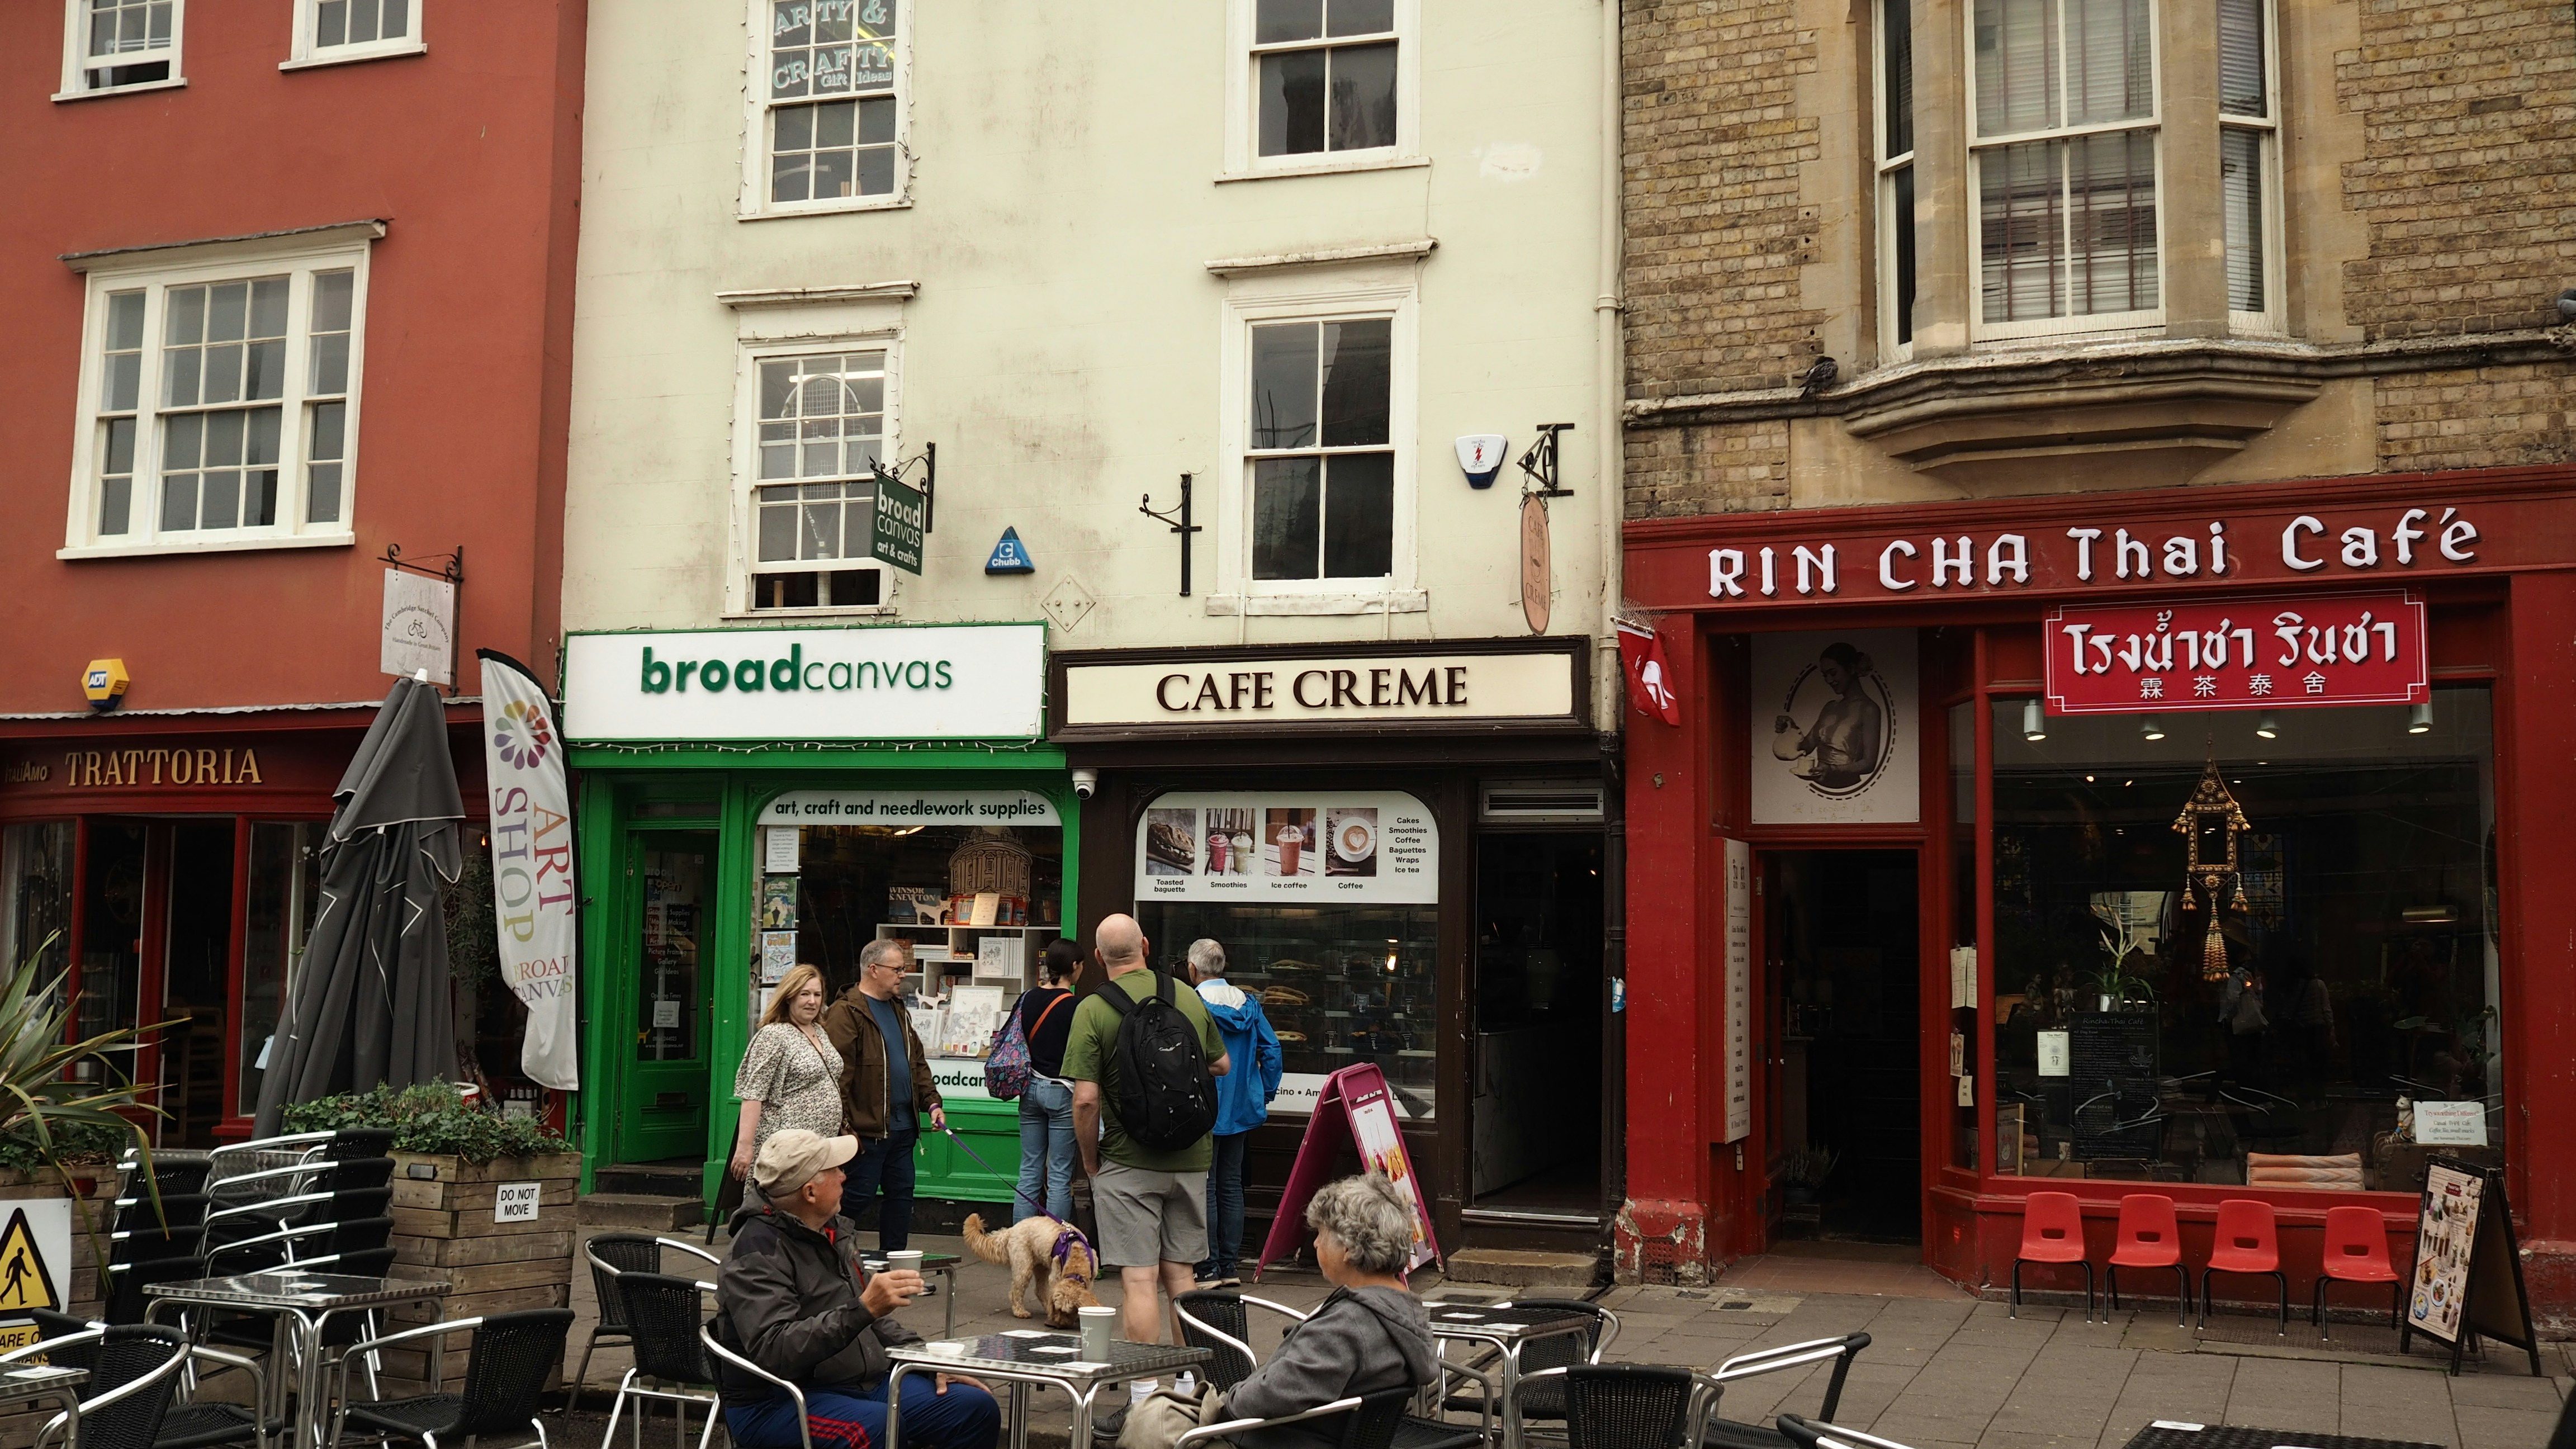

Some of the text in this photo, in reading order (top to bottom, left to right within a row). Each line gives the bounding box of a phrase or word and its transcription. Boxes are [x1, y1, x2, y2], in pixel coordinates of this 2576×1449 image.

[774, 0, 887, 36] ARTY &
[772, 43, 894, 88] CRAFTY
[820, 70, 893, 87] Gift Ideas
[878, 483, 921, 529] broad
[877, 514, 920, 547] canvas
[1528, 516, 1543, 541] CAFE
[877, 541, 917, 567] art & crafts
[992, 557, 1021, 566] Chubb
[1708, 507, 2479, 597] RIN CHA Thai Café
[1526, 583, 1546, 610] CREME
[2062, 609, 2395, 674] โรงน้ำชา รินชา
[89, 673, 106, 686] ADT
[641, 643, 953, 693] broadcanvas
[1156, 666, 1467, 712] CAFE CREME
[2140, 671, 2327, 699] 霖茶泰舍
[65, 749, 262, 786] TRATTORIA
[775, 799, 1045, 819] art, craft and needlework supplies
[495, 787, 534, 943] SHOP
[533, 801, 574, 916] ART
[501, 1188, 536, 1201] DO NOT
[504, 1204, 529, 1216] MOVE
